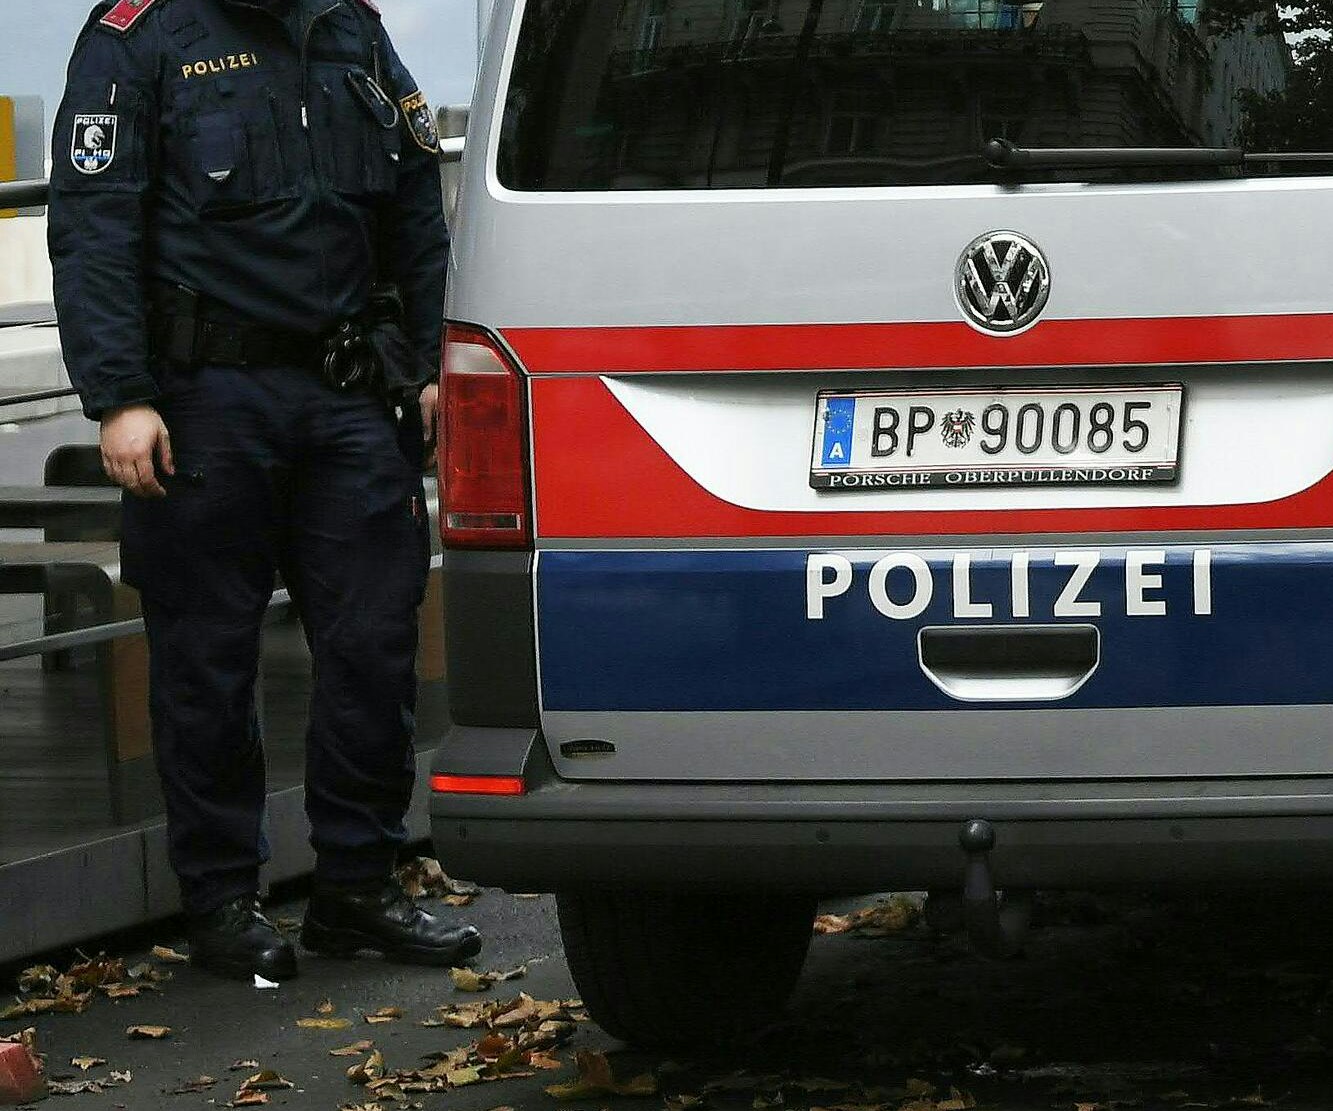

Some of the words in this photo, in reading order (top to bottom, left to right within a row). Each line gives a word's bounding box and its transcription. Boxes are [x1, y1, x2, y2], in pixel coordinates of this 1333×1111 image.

[181, 53, 258, 80] POLIZEI
[871, 405, 936, 458] BP
[980, 400, 1152, 455] 90085
[829, 442, 845, 459] A
[828, 473, 931, 487] PORSCHE
[945, 468, 1154, 485] OBERPULLENDORF
[806, 550, 1212, 621] POLIZEI
